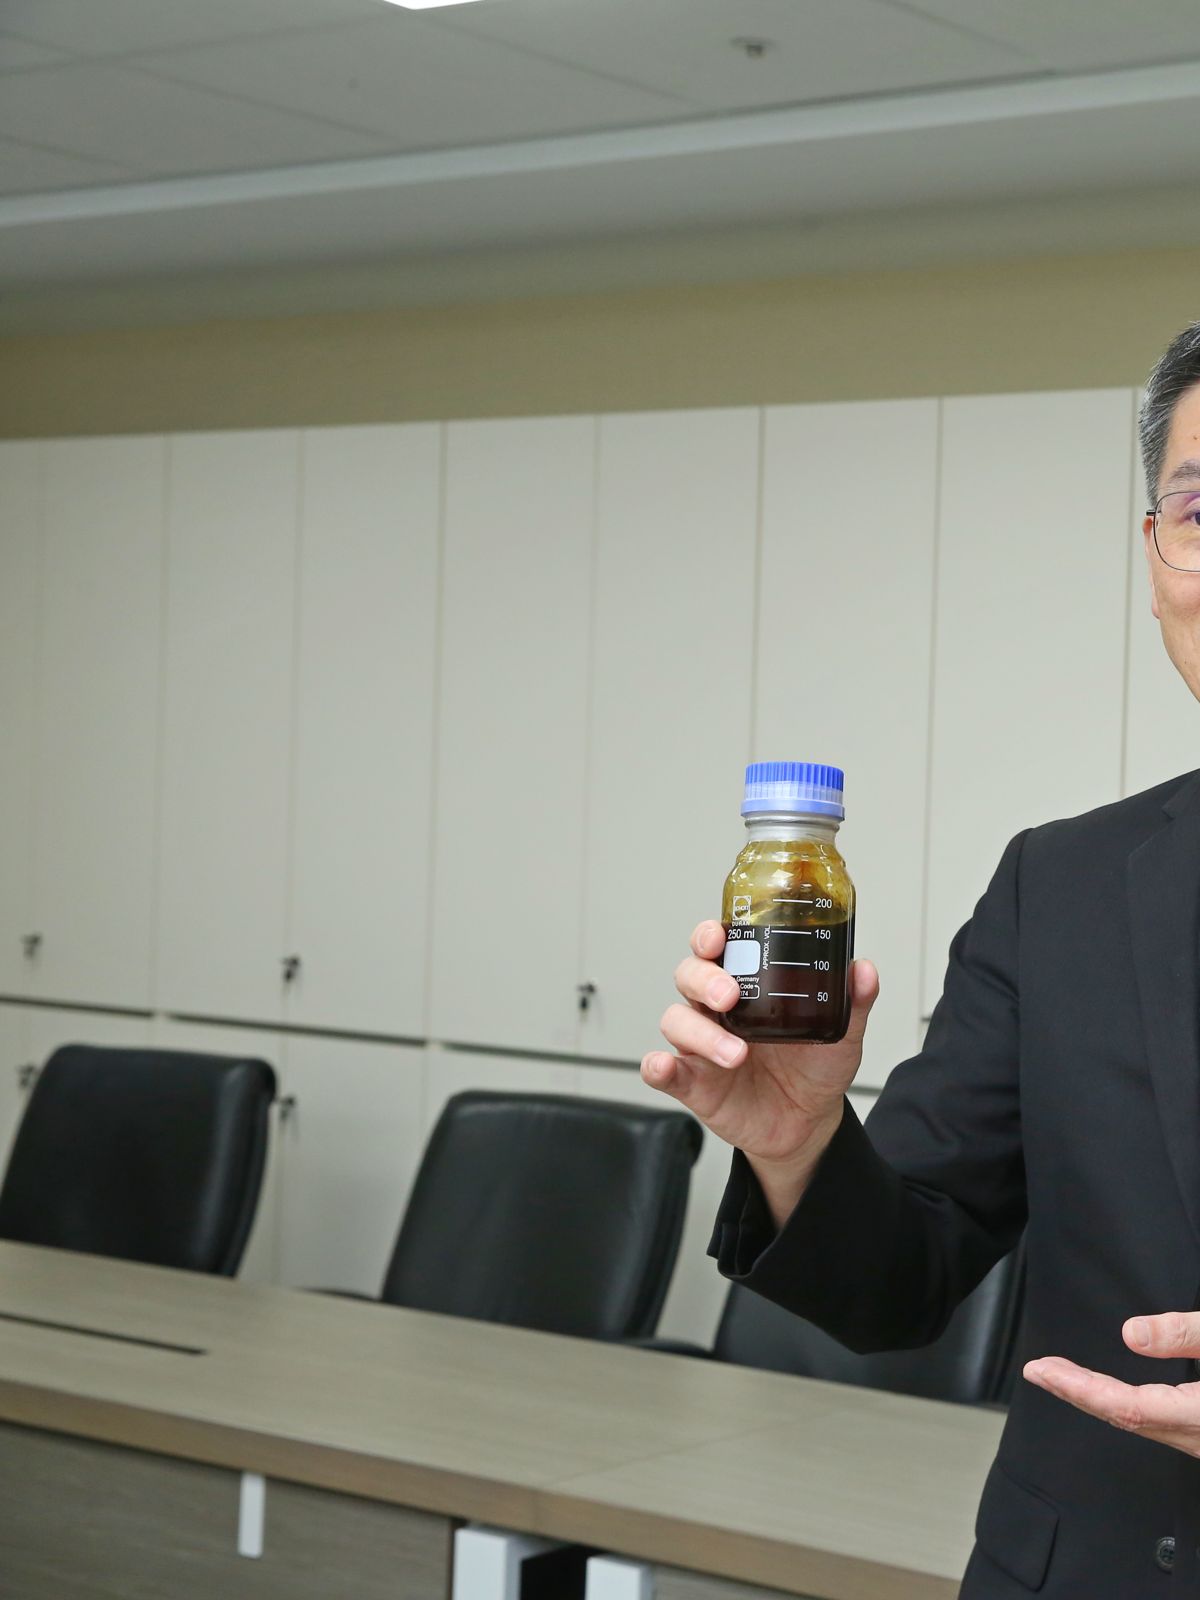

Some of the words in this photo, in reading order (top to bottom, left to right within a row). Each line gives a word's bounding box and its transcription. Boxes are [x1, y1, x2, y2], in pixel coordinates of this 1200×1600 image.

[815, 897, 833, 909] 200
[728, 929, 742, 939] 250
[743, 928, 755, 939] ml
[815, 929, 831, 939] 150
[813, 960, 830, 971] 100
[817, 992, 829, 1002] 50
